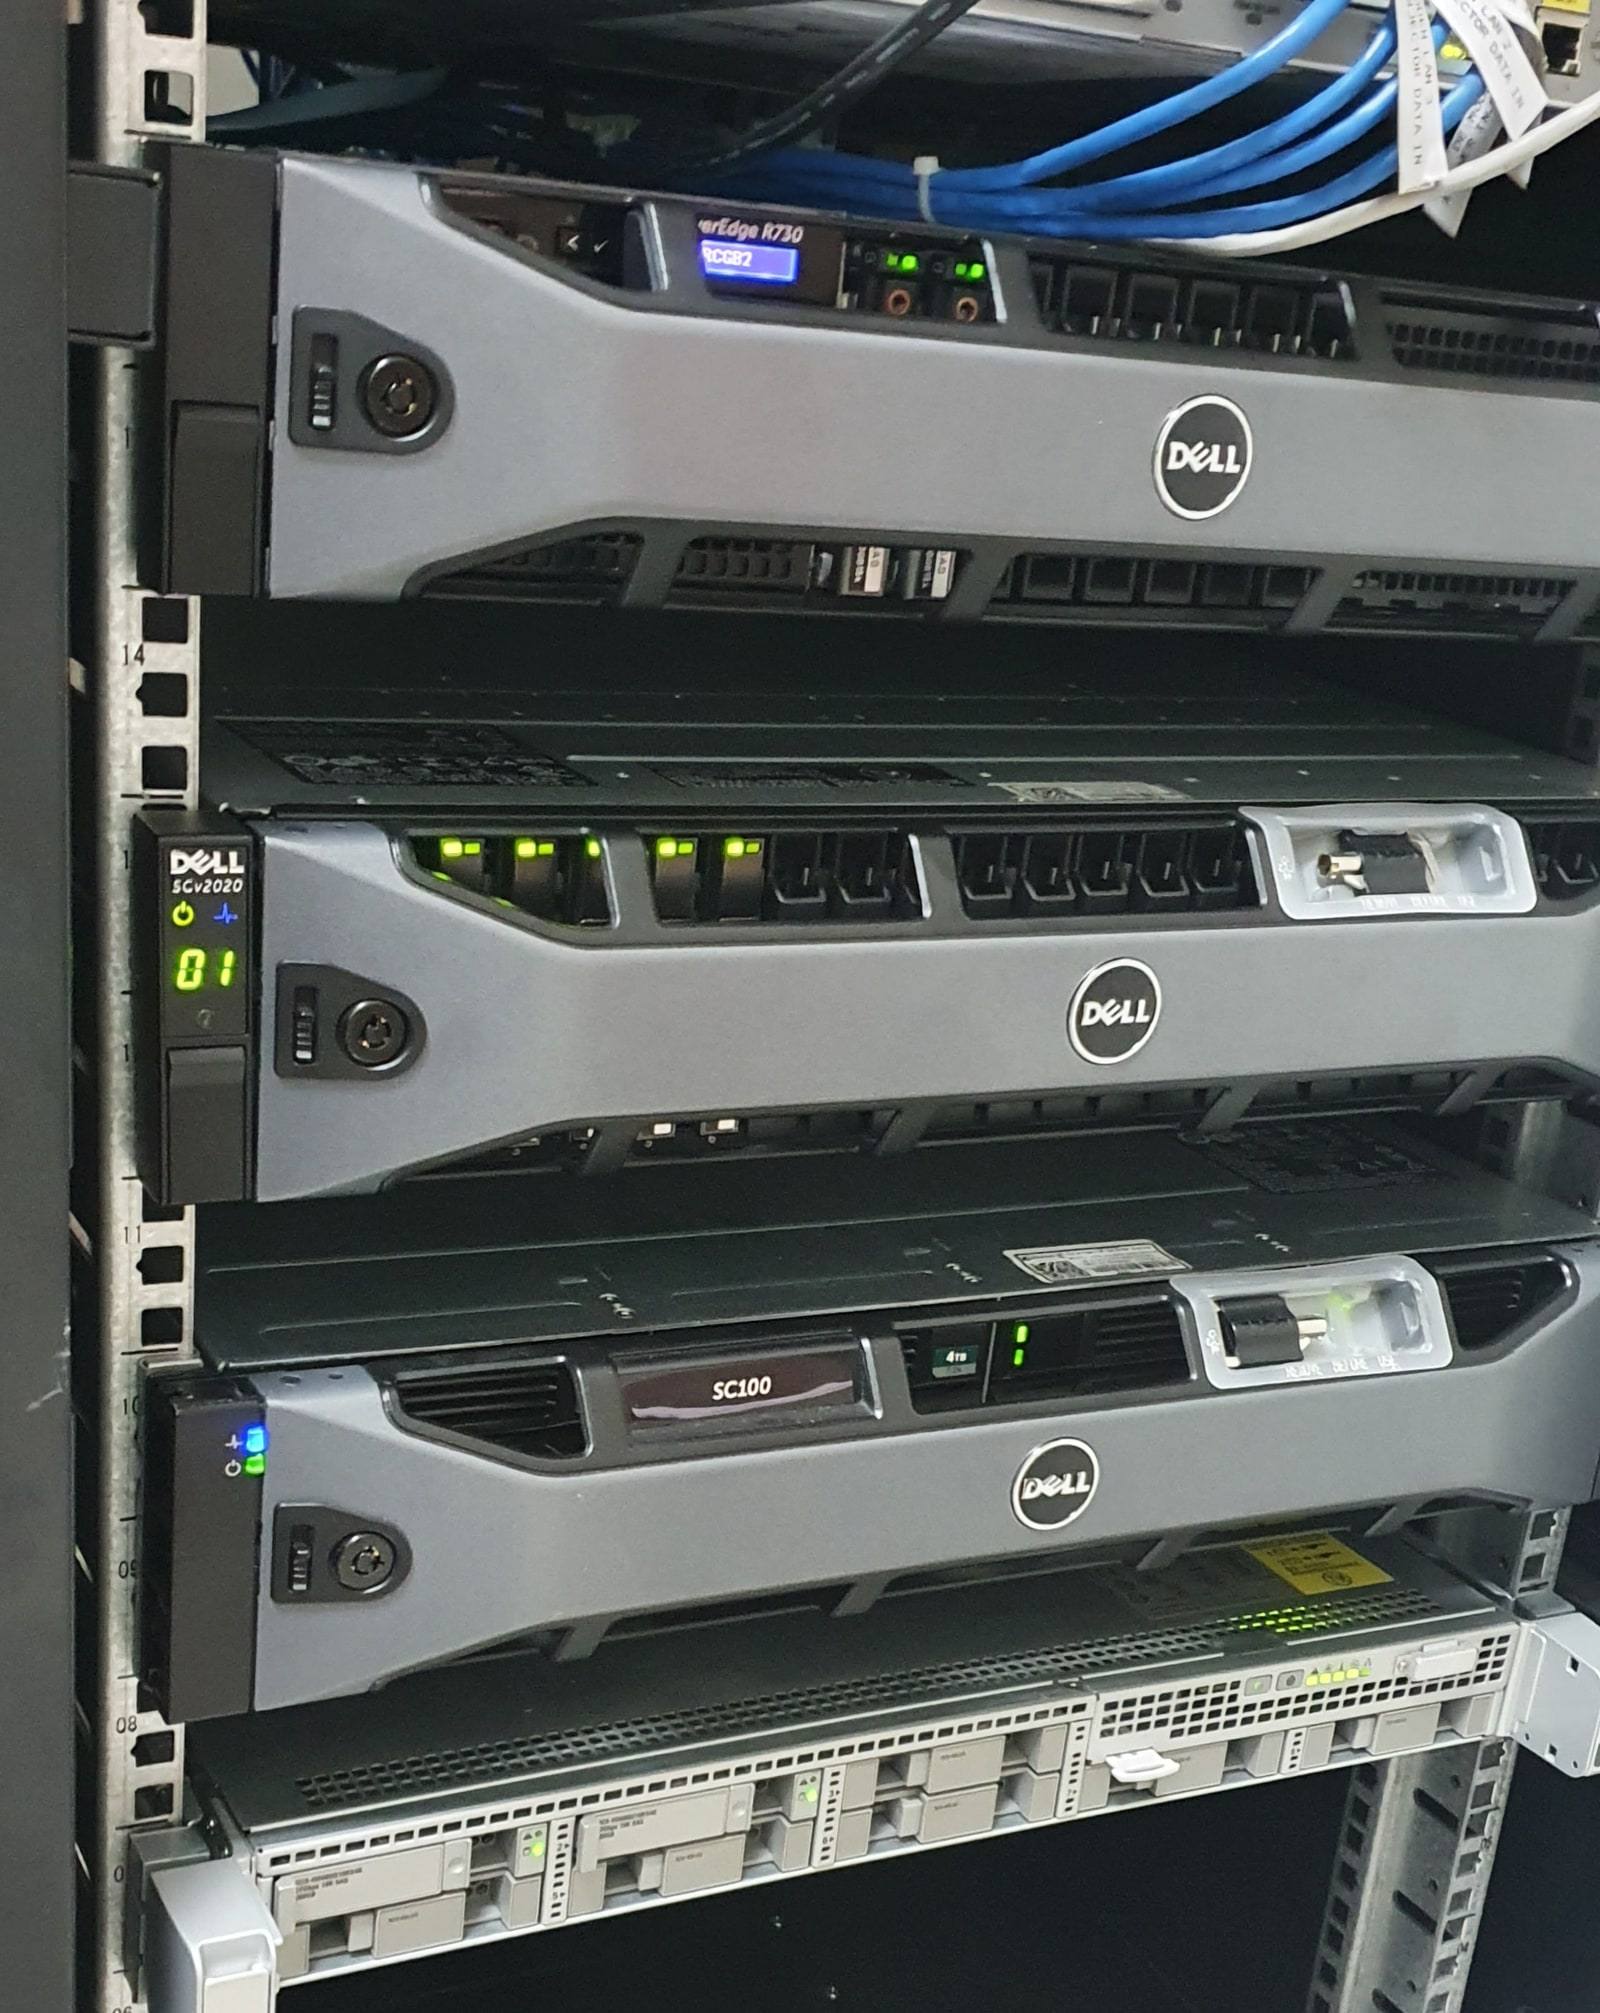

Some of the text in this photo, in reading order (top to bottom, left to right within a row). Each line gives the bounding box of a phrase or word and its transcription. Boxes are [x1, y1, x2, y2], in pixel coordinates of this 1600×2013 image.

[761, 222, 805, 244] R730
[1166, 440, 1241, 474] DELL
[123, 643, 146, 667] 14
[169, 849, 245, 876] DELL
[172, 878, 244, 895] SCv2020
[176, 947, 236, 991] 01
[1080, 998, 1151, 1027] DELL
[124, 1225, 142, 1245] 11
[711, 1375, 773, 1401] SC100
[1021, 1471, 1091, 1500] DELL
[115, 1715, 138, 1734] 08
